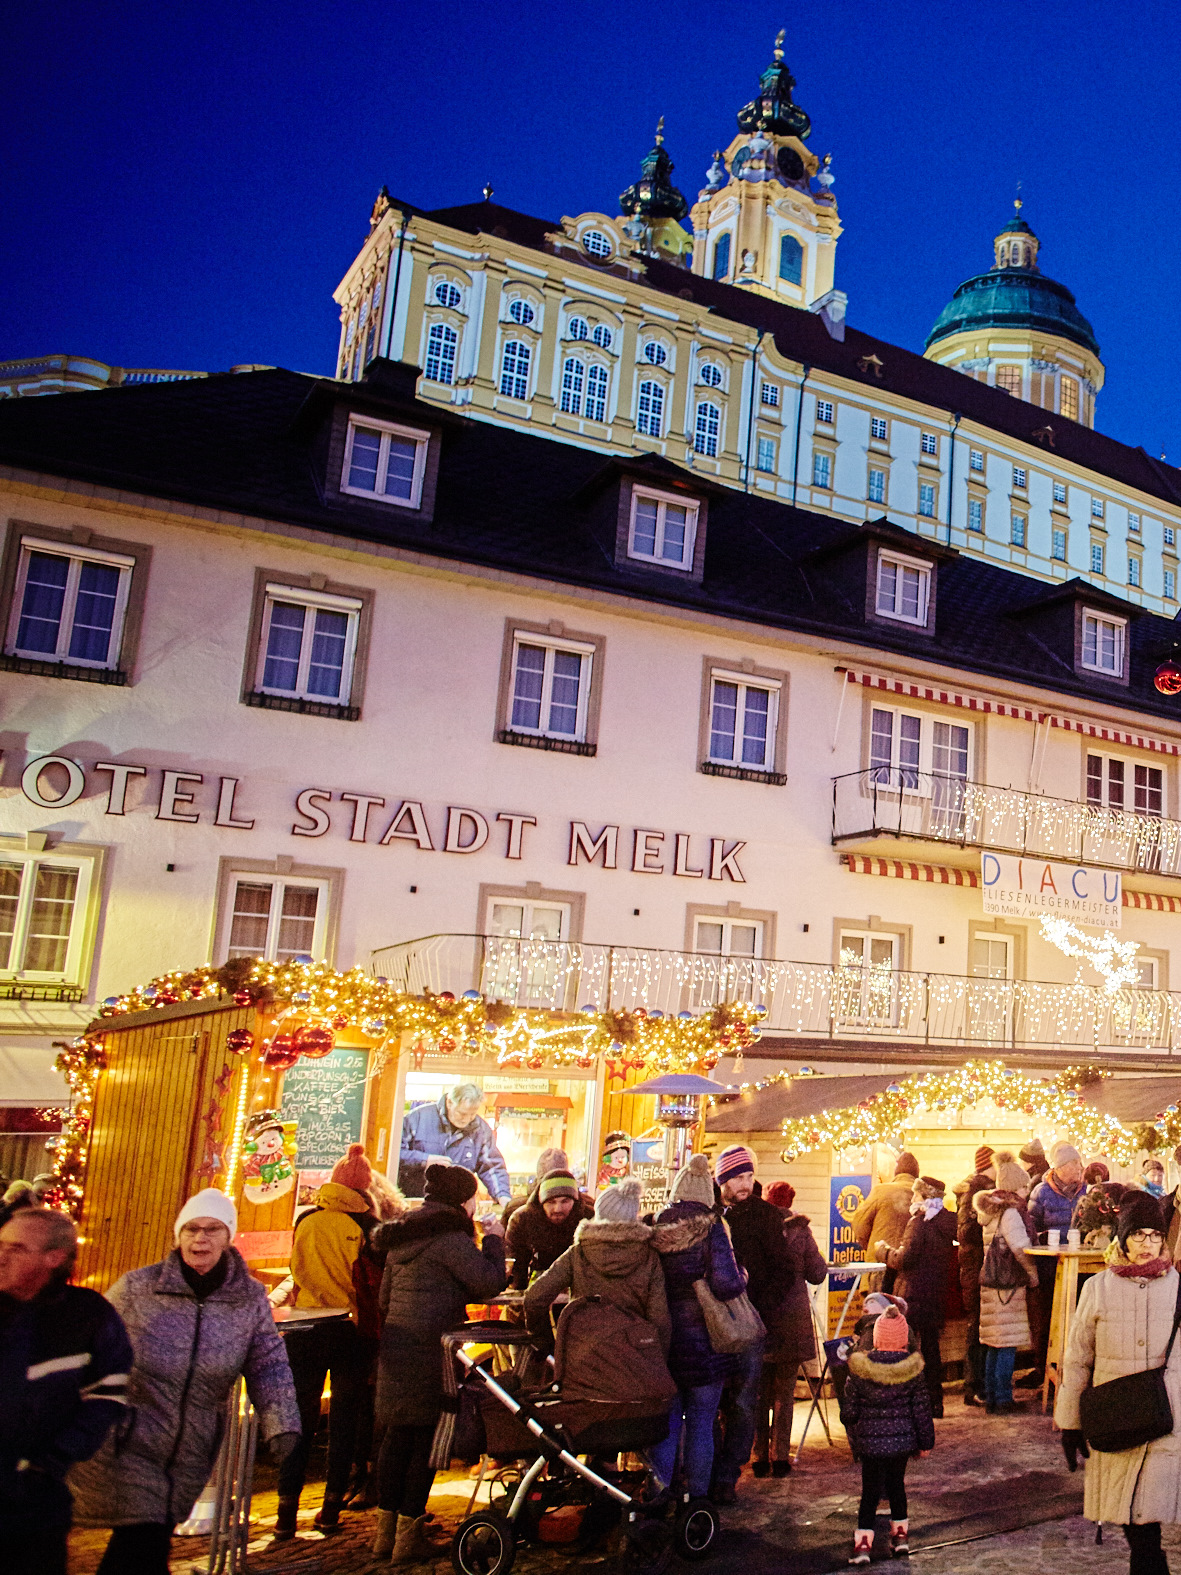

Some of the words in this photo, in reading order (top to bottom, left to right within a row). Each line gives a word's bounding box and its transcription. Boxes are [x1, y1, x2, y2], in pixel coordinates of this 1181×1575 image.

[0, 749, 256, 830] OTEL
[291, 788, 537, 860] STADT
[567, 821, 747, 883] MELK
[983, 854, 1119, 903] DIACU
[984, 902, 1000, 913] 390
[1001, 905, 1020, 915] Melk
[293, 1082, 338, 1092] KAFFEE
[319, 1104, 347, 1115] BIER
[296, 1131, 342, 1143] POPCORN
[846, 1196, 855, 1211] L
[833, 1226, 859, 1244] LIO
[833, 1246, 866, 1263] helfen
